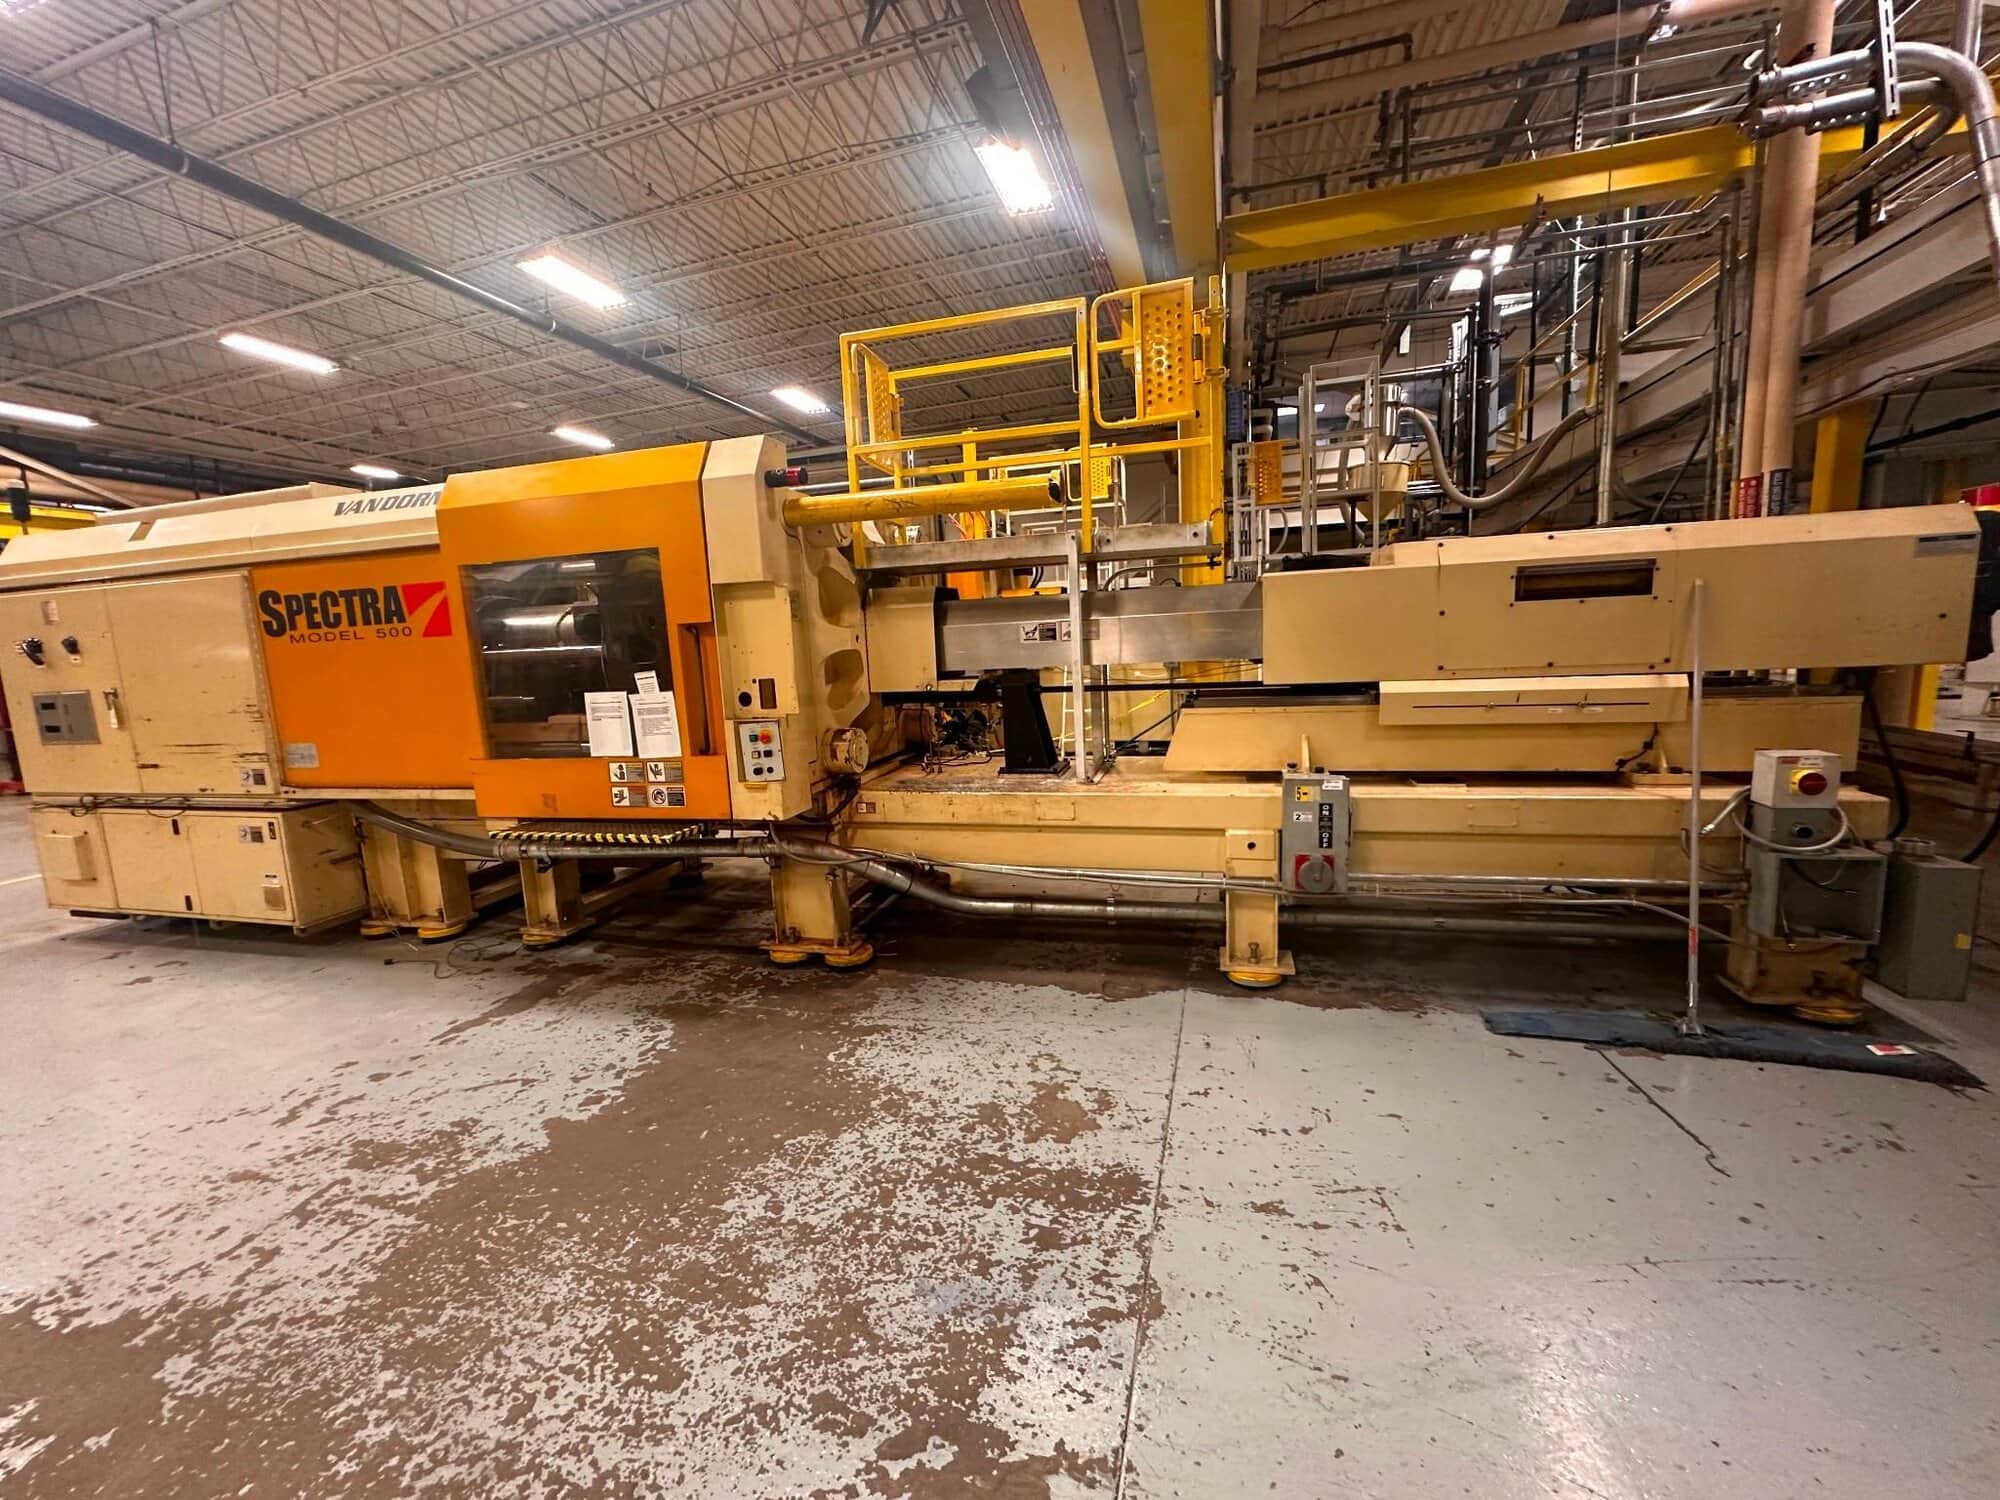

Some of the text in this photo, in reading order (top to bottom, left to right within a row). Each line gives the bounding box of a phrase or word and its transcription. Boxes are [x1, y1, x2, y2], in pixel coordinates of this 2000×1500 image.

[259, 585, 406, 638] SPECTRA
[289, 626, 412, 644] MODEL 500
[1322, 832, 1330, 848] OFF
